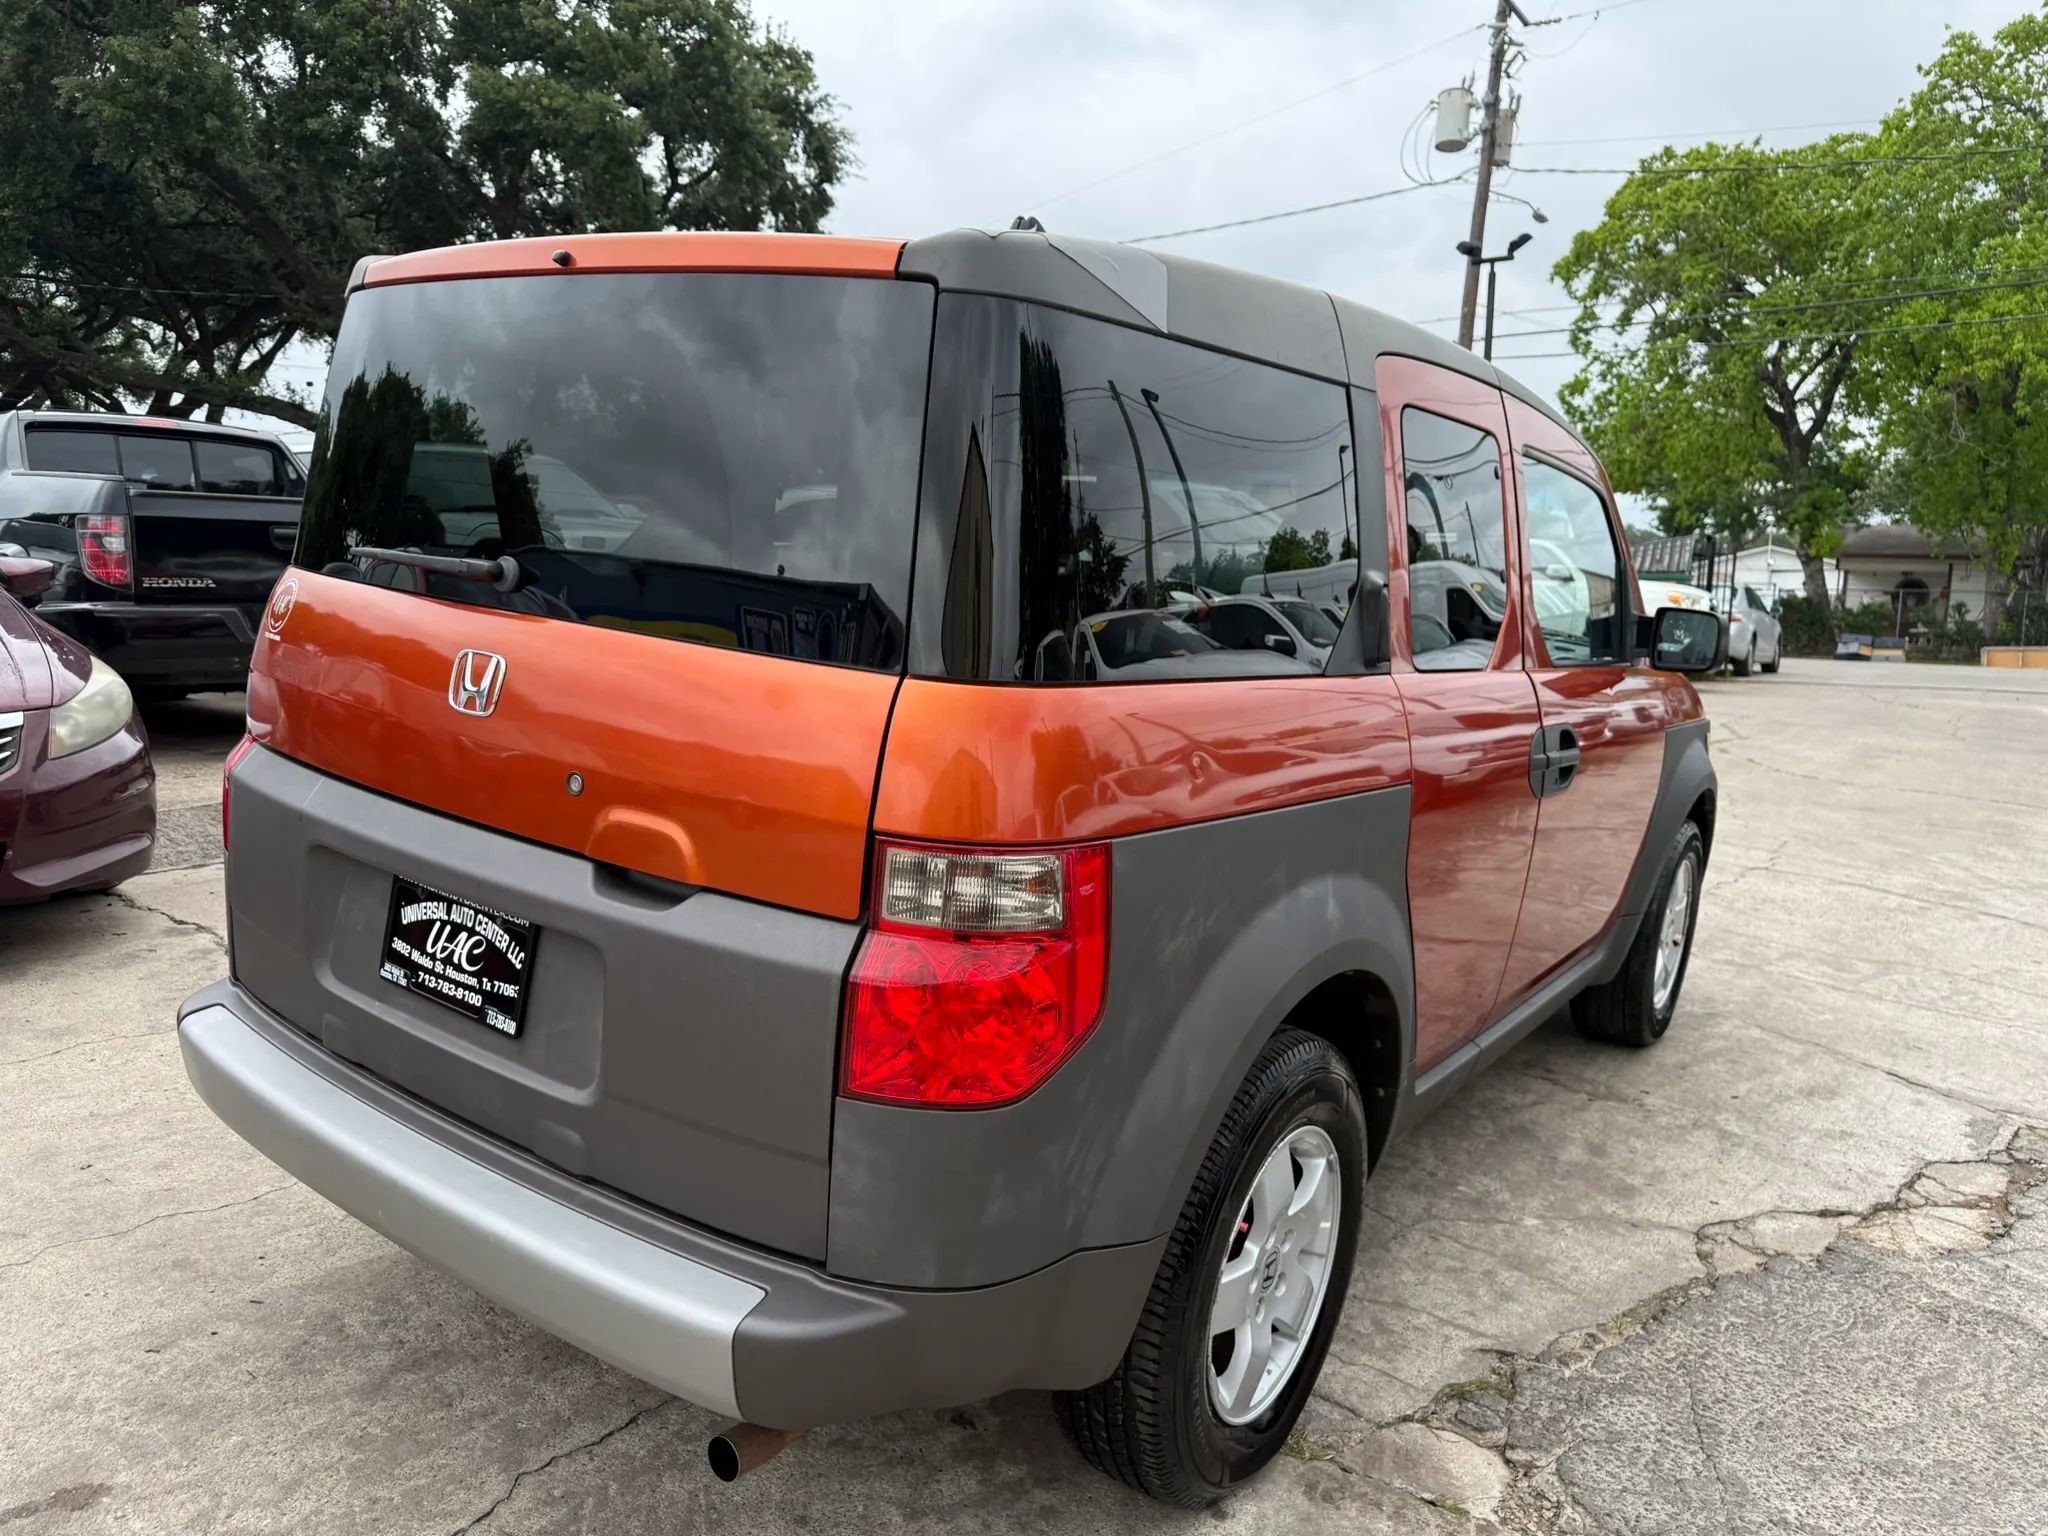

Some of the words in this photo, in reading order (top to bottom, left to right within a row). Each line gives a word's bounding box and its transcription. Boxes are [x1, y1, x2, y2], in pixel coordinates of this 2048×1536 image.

[142, 577, 217, 588] HONDA
[401, 901, 449, 925] UNIVERSAL
[450, 904, 474, 928] AUTO
[475, 913, 509, 952] CENTER
[508, 941, 525, 970] LLC
[426, 921, 487, 971] UAC
[391, 937, 410, 956] 3802
[410, 950, 433, 970] Waldo
[434, 959, 445, 974] St
[445, 964, 480, 989] Houston,
[482, 977, 492, 992] Tx
[418, 971, 483, 1007] 713-783-8100
